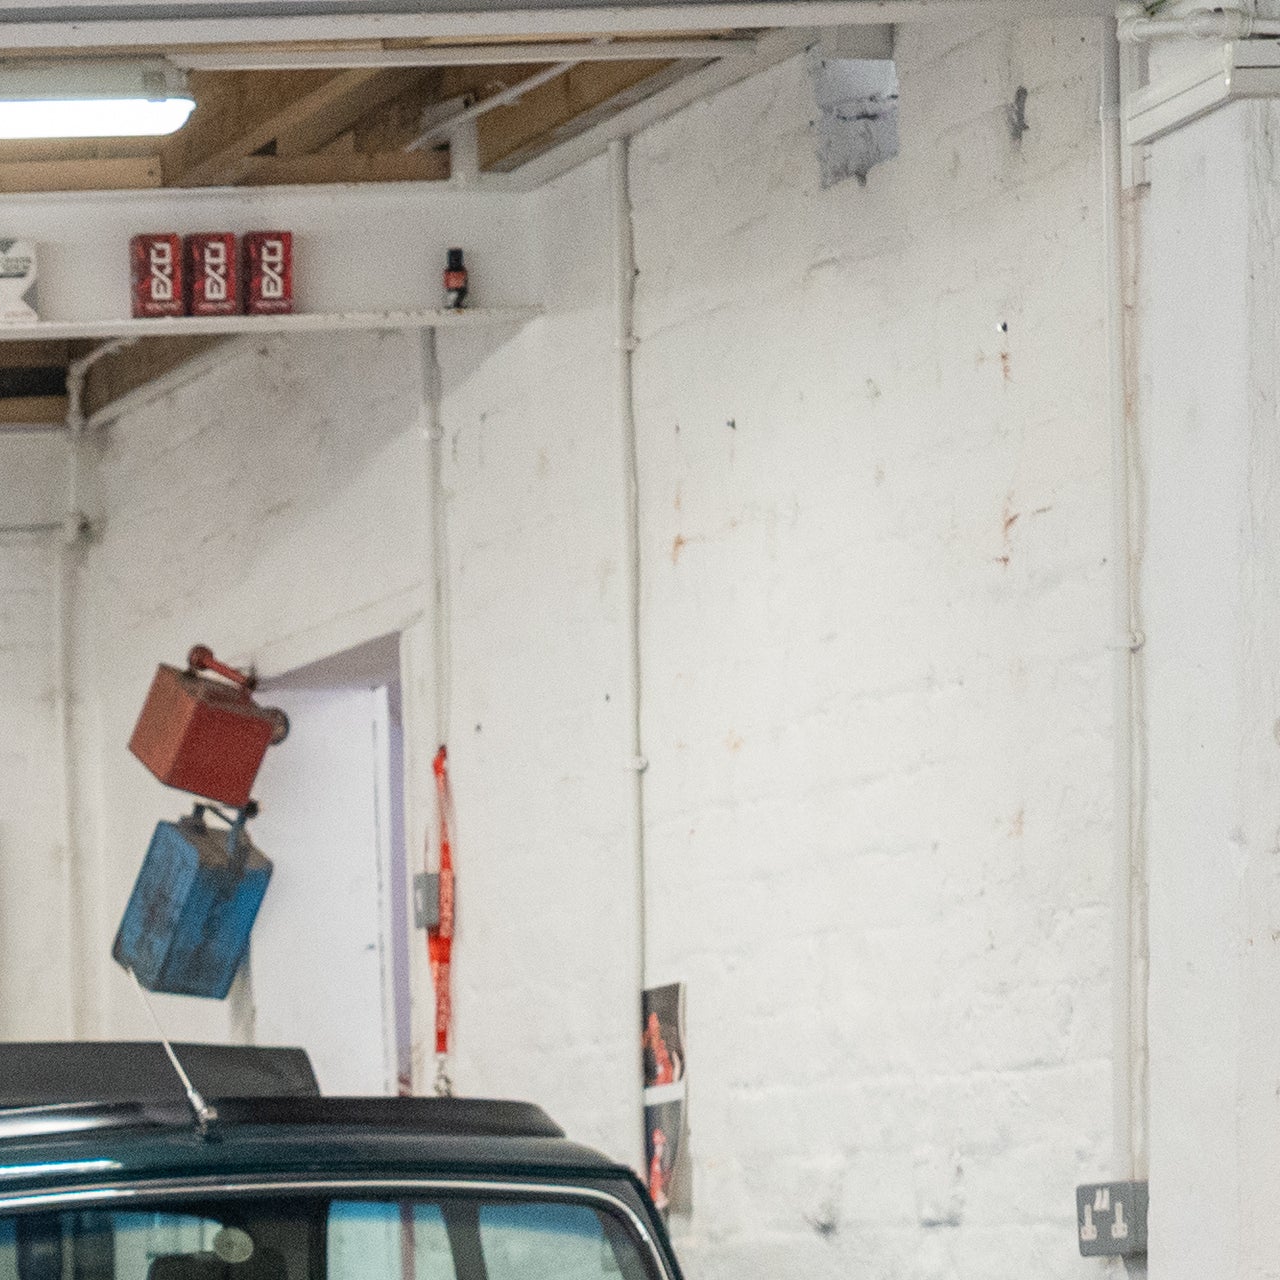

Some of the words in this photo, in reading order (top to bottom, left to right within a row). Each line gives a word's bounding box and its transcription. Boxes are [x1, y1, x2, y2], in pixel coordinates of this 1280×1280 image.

[151, 242, 172, 300] EXO
[206, 242, 226, 300] EXO
[262, 240, 282, 298] EXO
